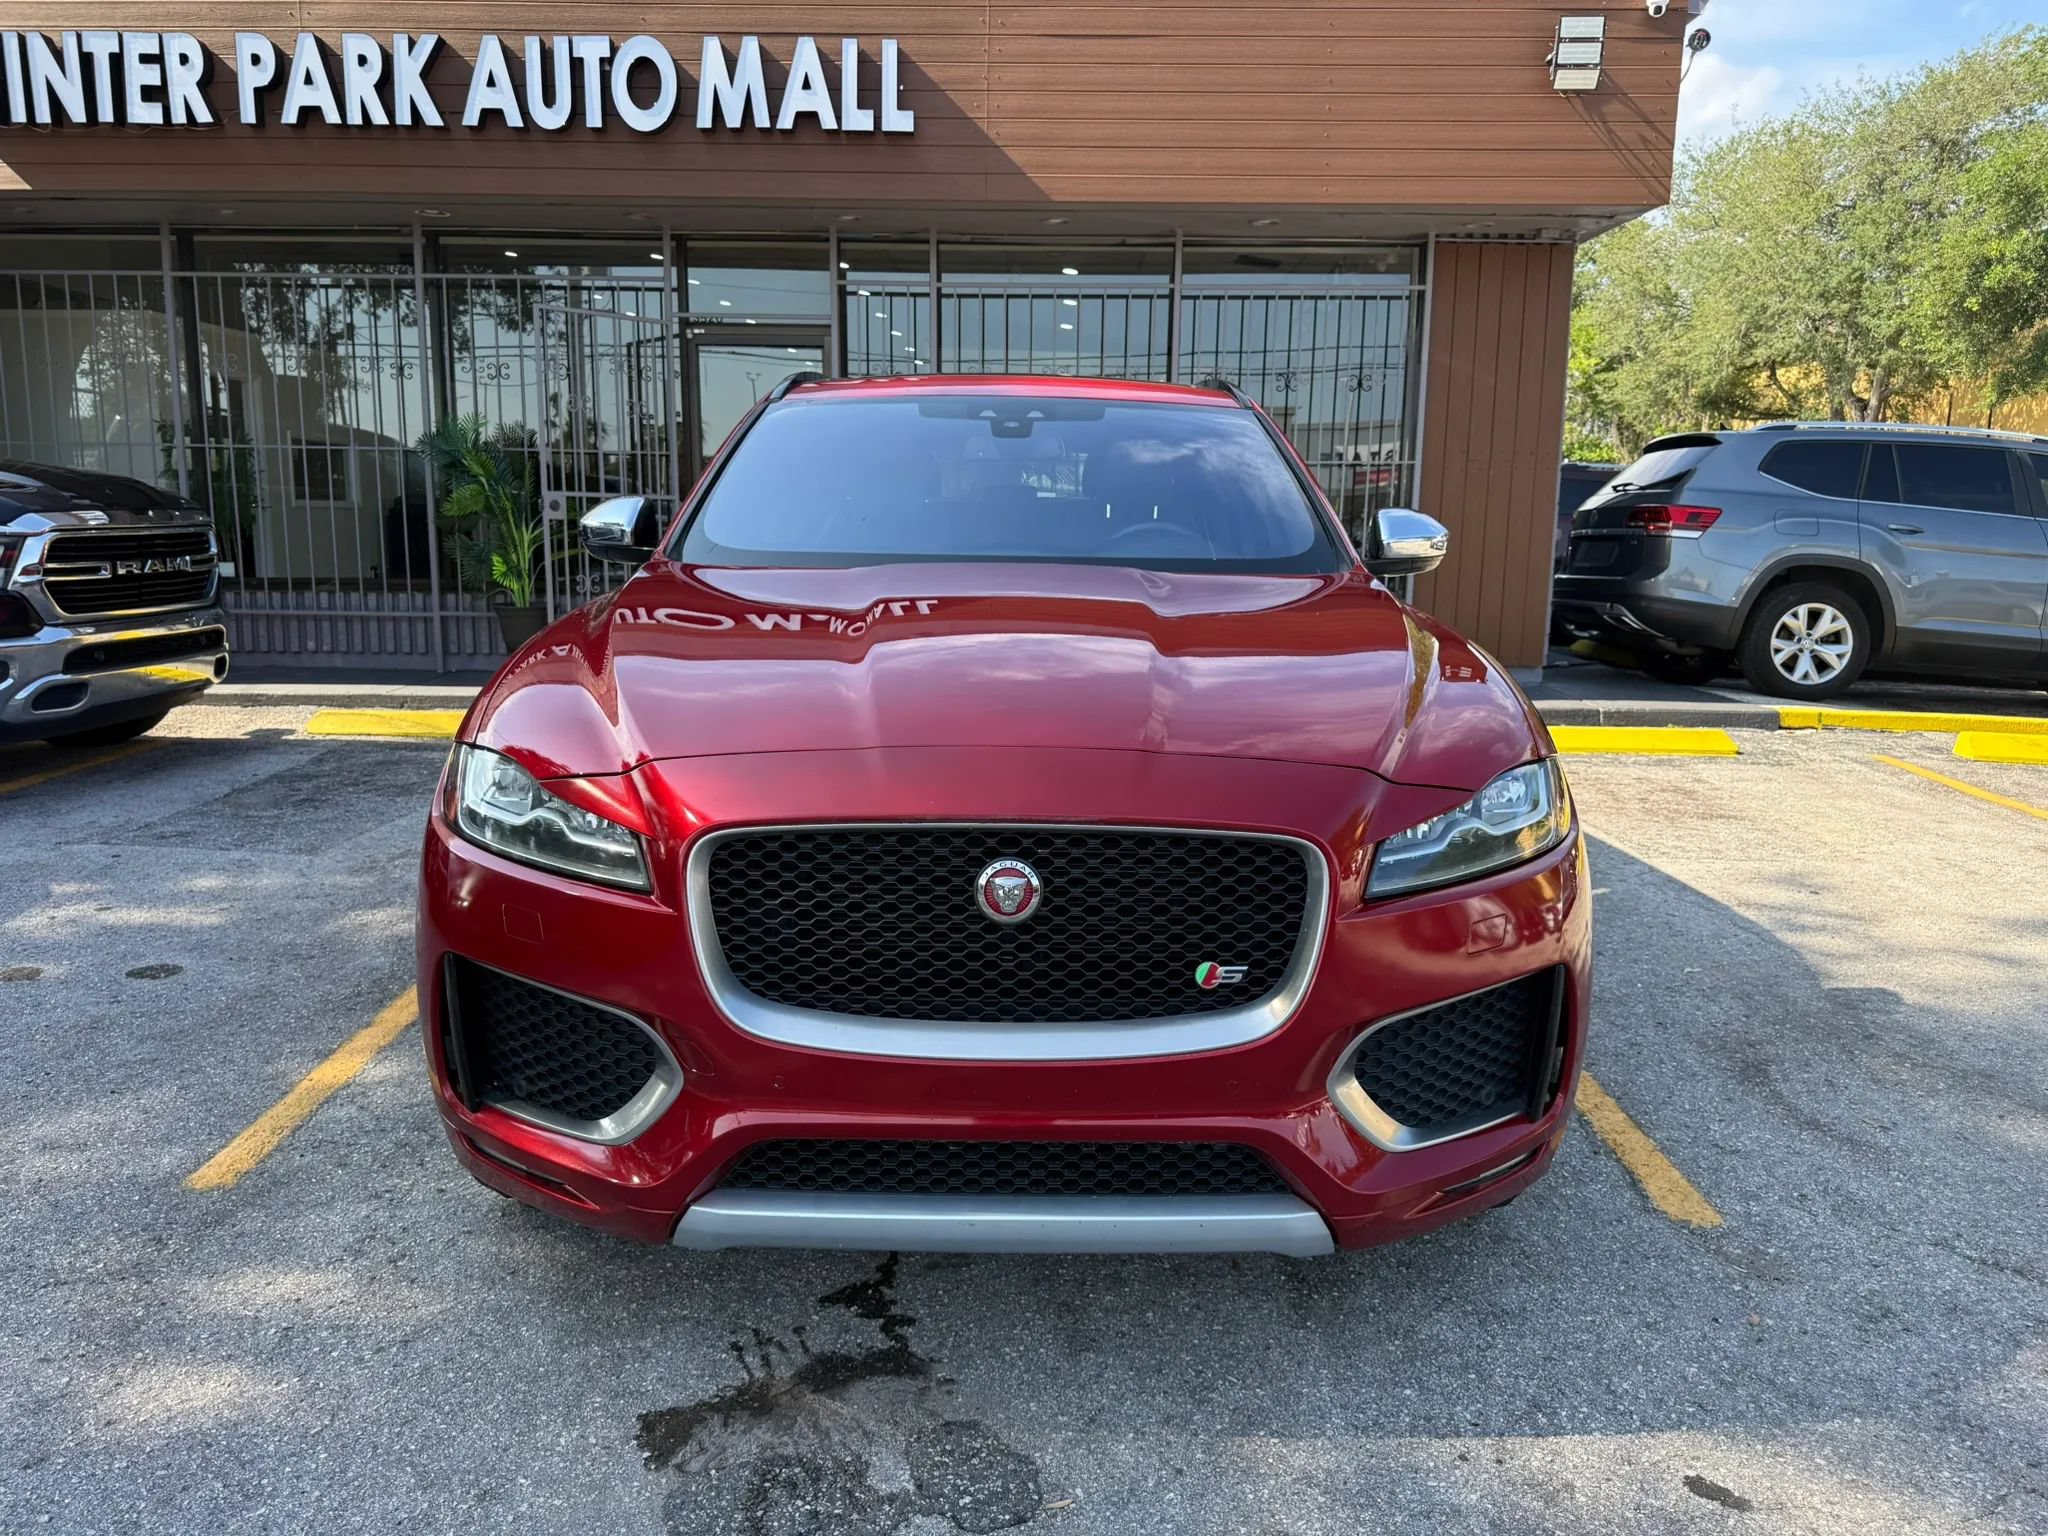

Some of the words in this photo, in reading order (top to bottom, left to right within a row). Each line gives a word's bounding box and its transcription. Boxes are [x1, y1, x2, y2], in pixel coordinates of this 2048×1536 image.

[0, 30, 214, 125] INTER
[235, 32, 444, 127] PARK
[462, 35, 677, 132] AUTO
[696, 36, 914, 133] MALL
[117, 555, 192, 574] RAM
[984, 861, 1035, 880] JAGUAR
